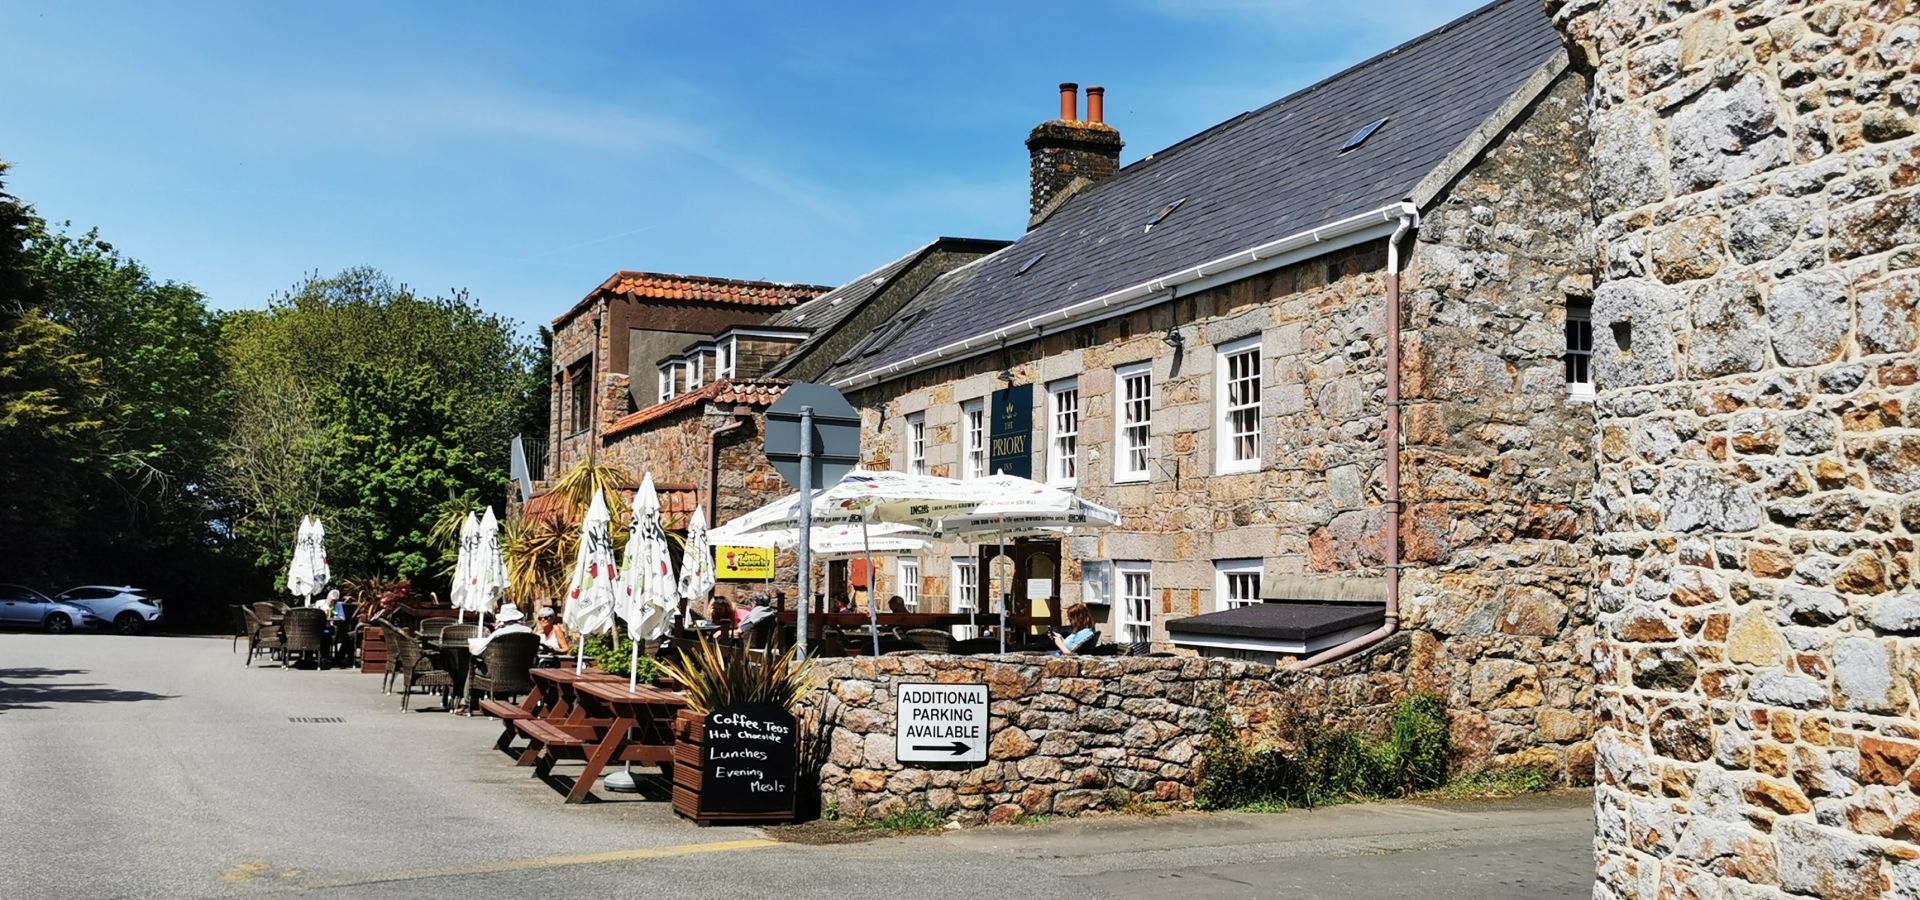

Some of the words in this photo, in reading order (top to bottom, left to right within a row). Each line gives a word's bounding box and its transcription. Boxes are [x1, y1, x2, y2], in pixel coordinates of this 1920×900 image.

[1004, 421, 1014, 430] THE
[992, 435, 1027, 457] PRIORY
[902, 691, 984, 705] ADDITIONAL
[913, 708, 973, 721] PARKING
[709, 729, 732, 739] Hot
[763, 721, 789, 734] Teas
[906, 725, 979, 738] AVAILABLE
[710, 747, 768, 761] Lunches
[715, 766, 764, 780] Evening
[750, 779, 785, 793] Meals
